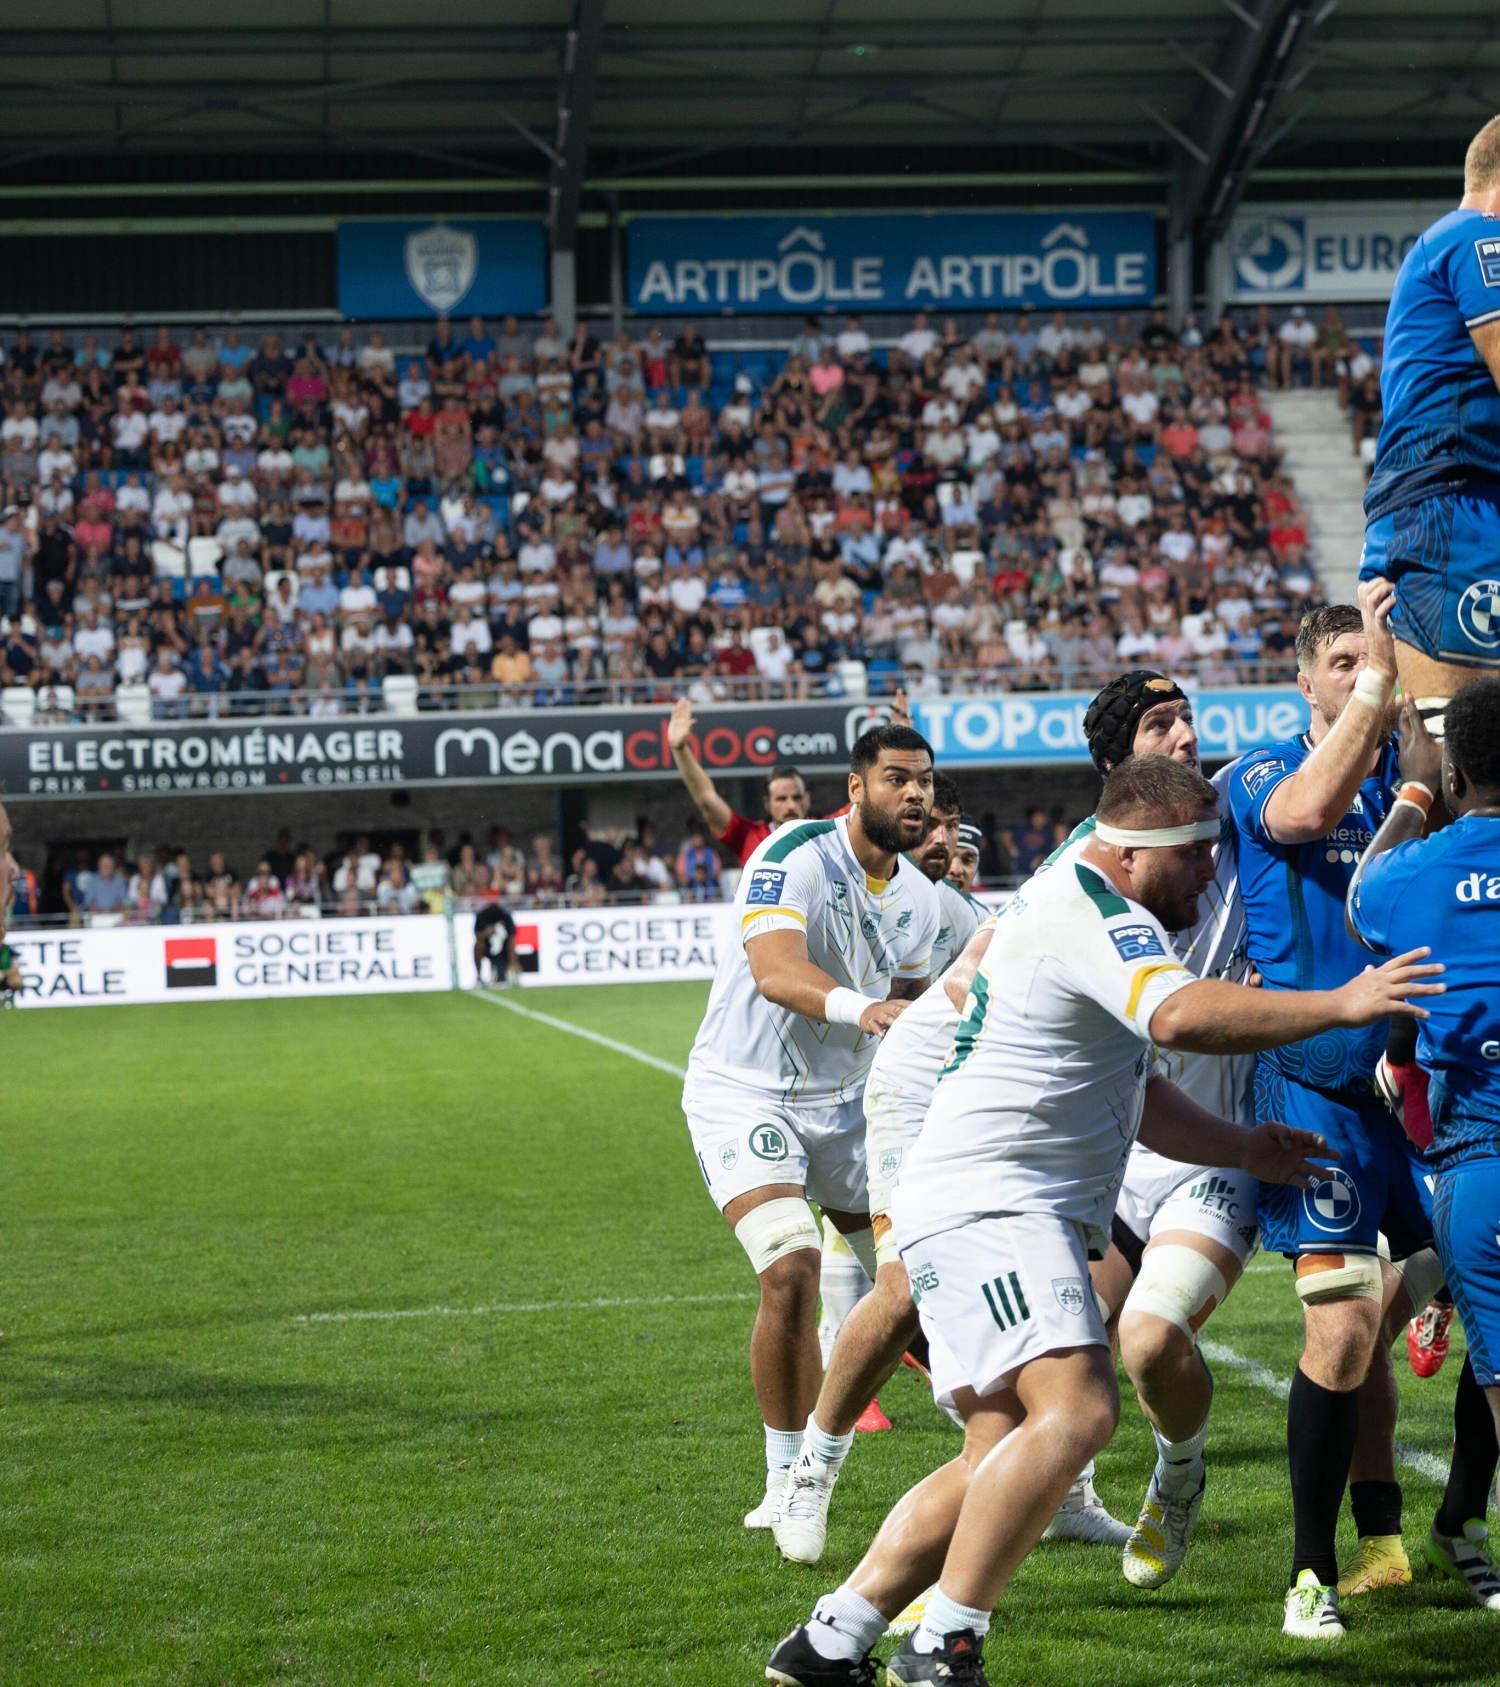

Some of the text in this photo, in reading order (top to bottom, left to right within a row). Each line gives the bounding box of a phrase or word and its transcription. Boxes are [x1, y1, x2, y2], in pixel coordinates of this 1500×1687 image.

[639, 223, 1148, 303] ARTIPÔLE ARTIPÔLE
[28, 727, 404, 772] ELECTROMÉNAGER
[29, 764, 405, 794] PRIX SHOWROOM CONSEIL
[1326, 827, 1375, 844] Neste
[753, 870, 782, 882] PRO
[749, 887, 777, 901] D2
[235, 929, 395, 958] SOCIETE
[557, 916, 714, 945] SOCIETE
[1113, 927, 1153, 941] PRO
[557, 947, 718, 973] GENERAL
[1122, 941, 1164, 956] D2
[234, 956, 434, 987] GENERALE
[1202, 1194, 1240, 1220] ETC
